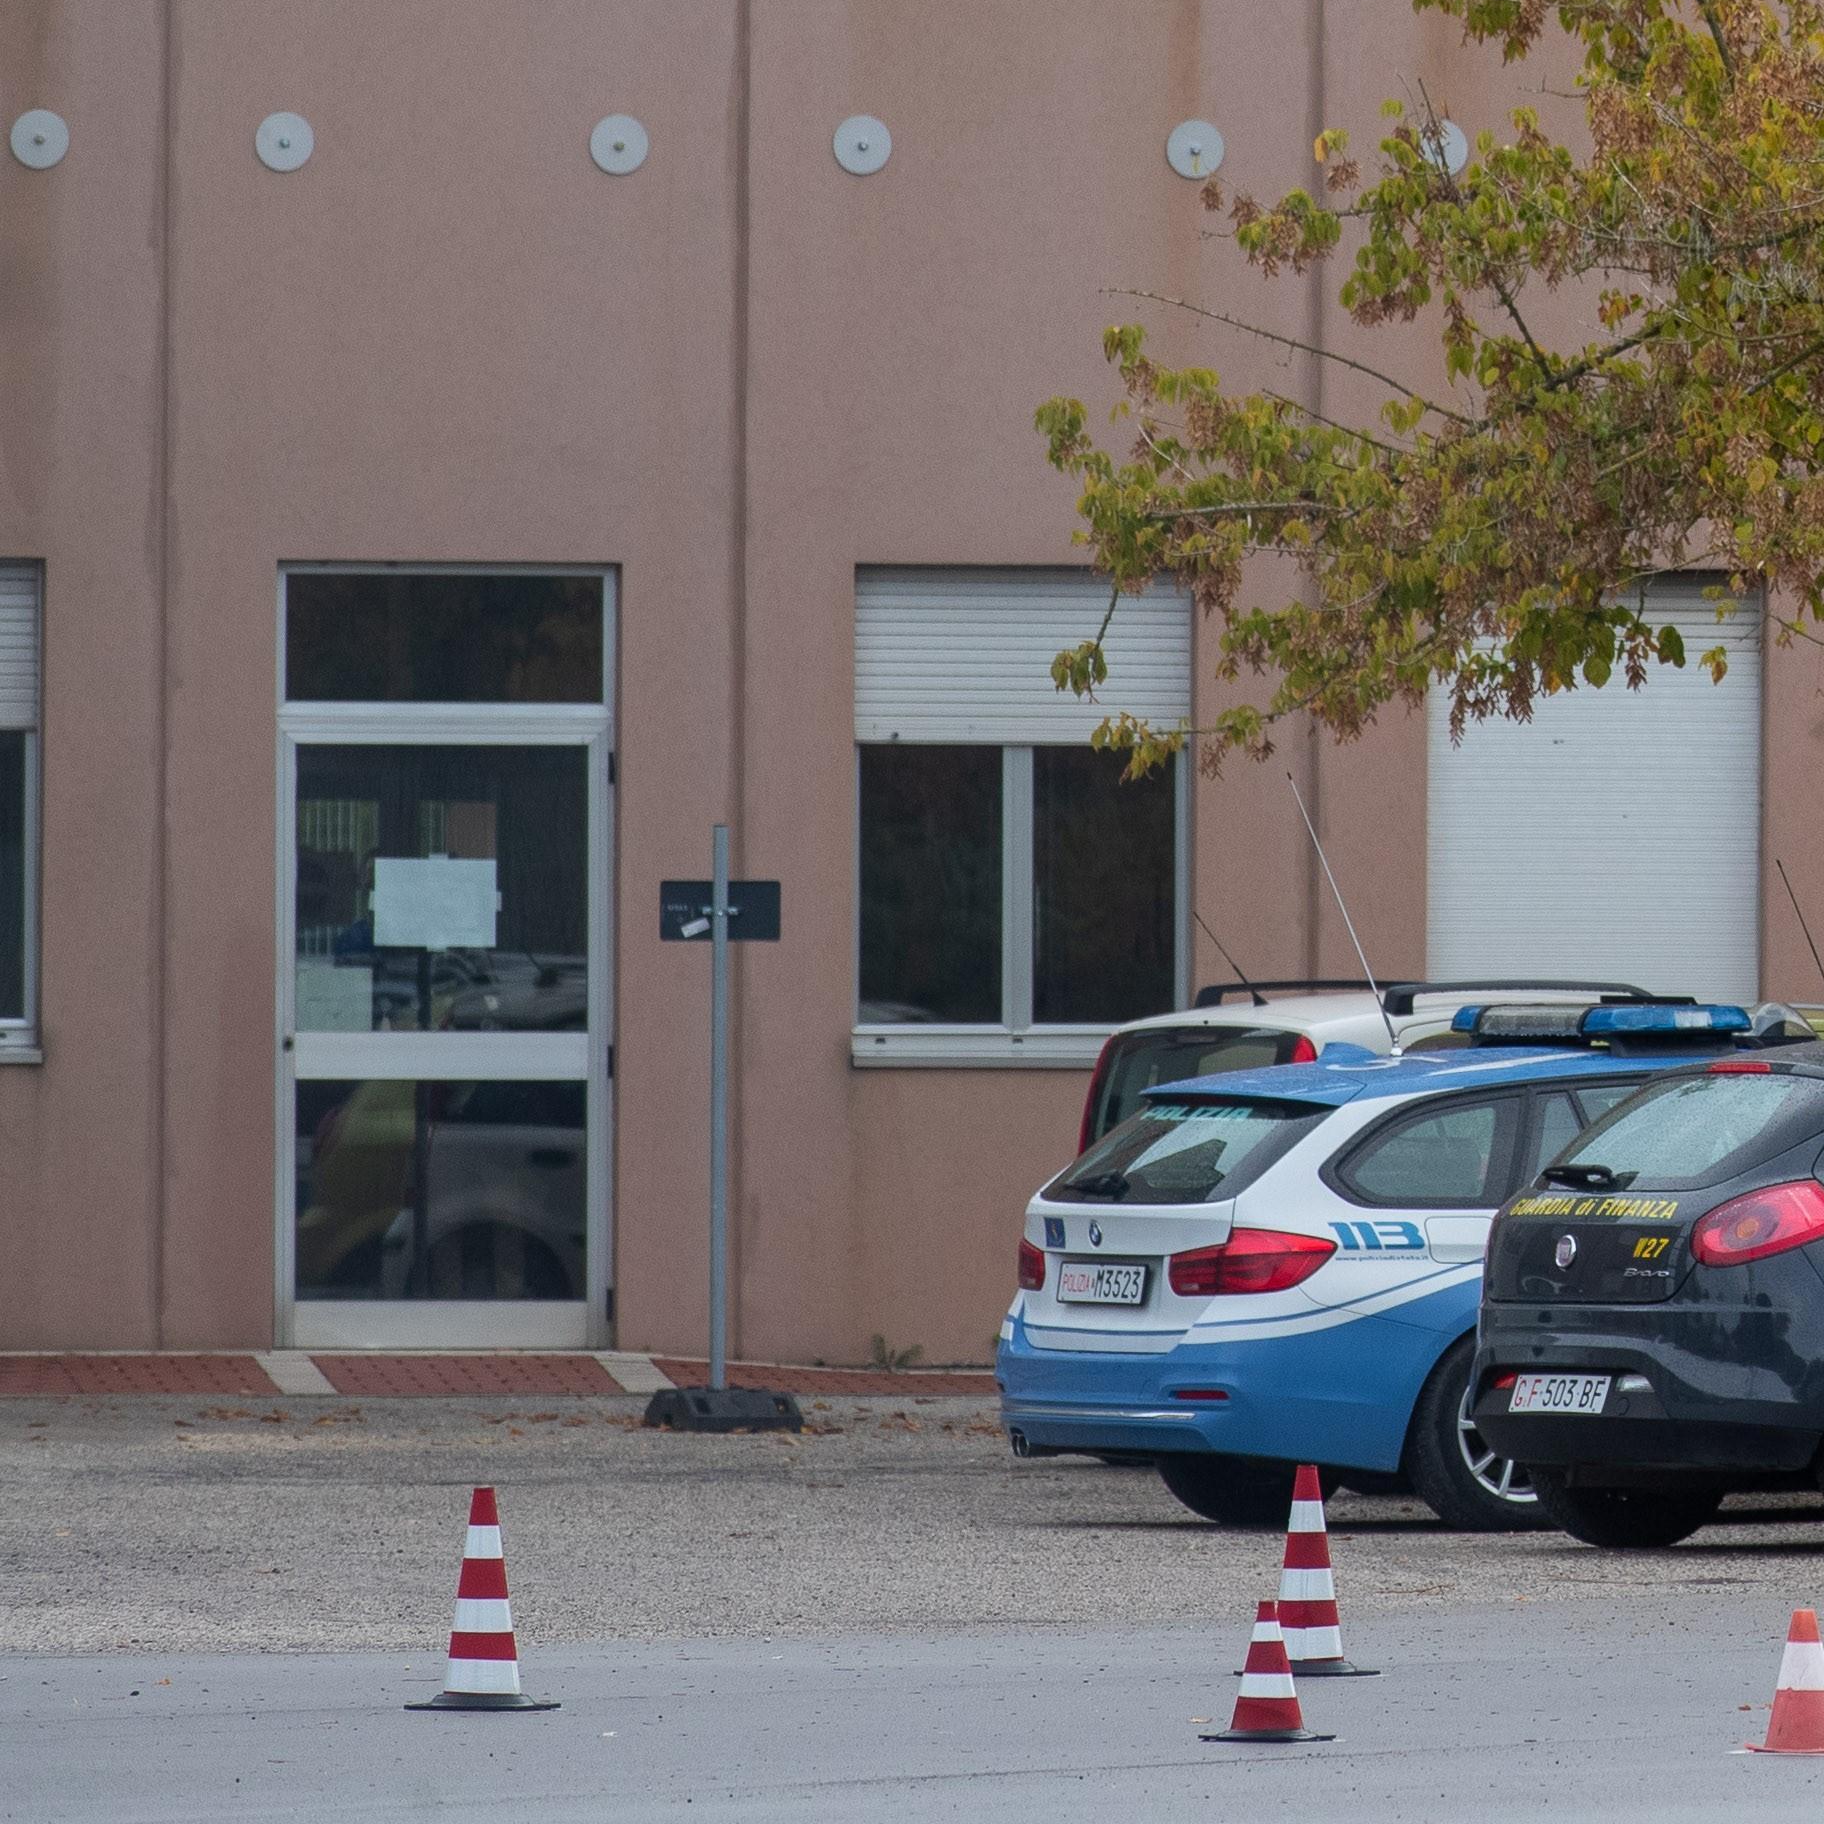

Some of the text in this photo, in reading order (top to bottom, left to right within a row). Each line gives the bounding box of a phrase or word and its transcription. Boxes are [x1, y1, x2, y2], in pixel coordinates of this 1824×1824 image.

[1140, 1105, 1253, 1121] POLIZIA
[1510, 1198, 1679, 1220] GUARDIA di FINANZA
[1327, 1221, 1426, 1251] 113
[1093, 1269, 1142, 1300] M3523
[1623, 1268, 1670, 1277] Bravo
[1542, 1378, 1579, 1407] 503
[1579, 1379, 1606, 1409] BF
